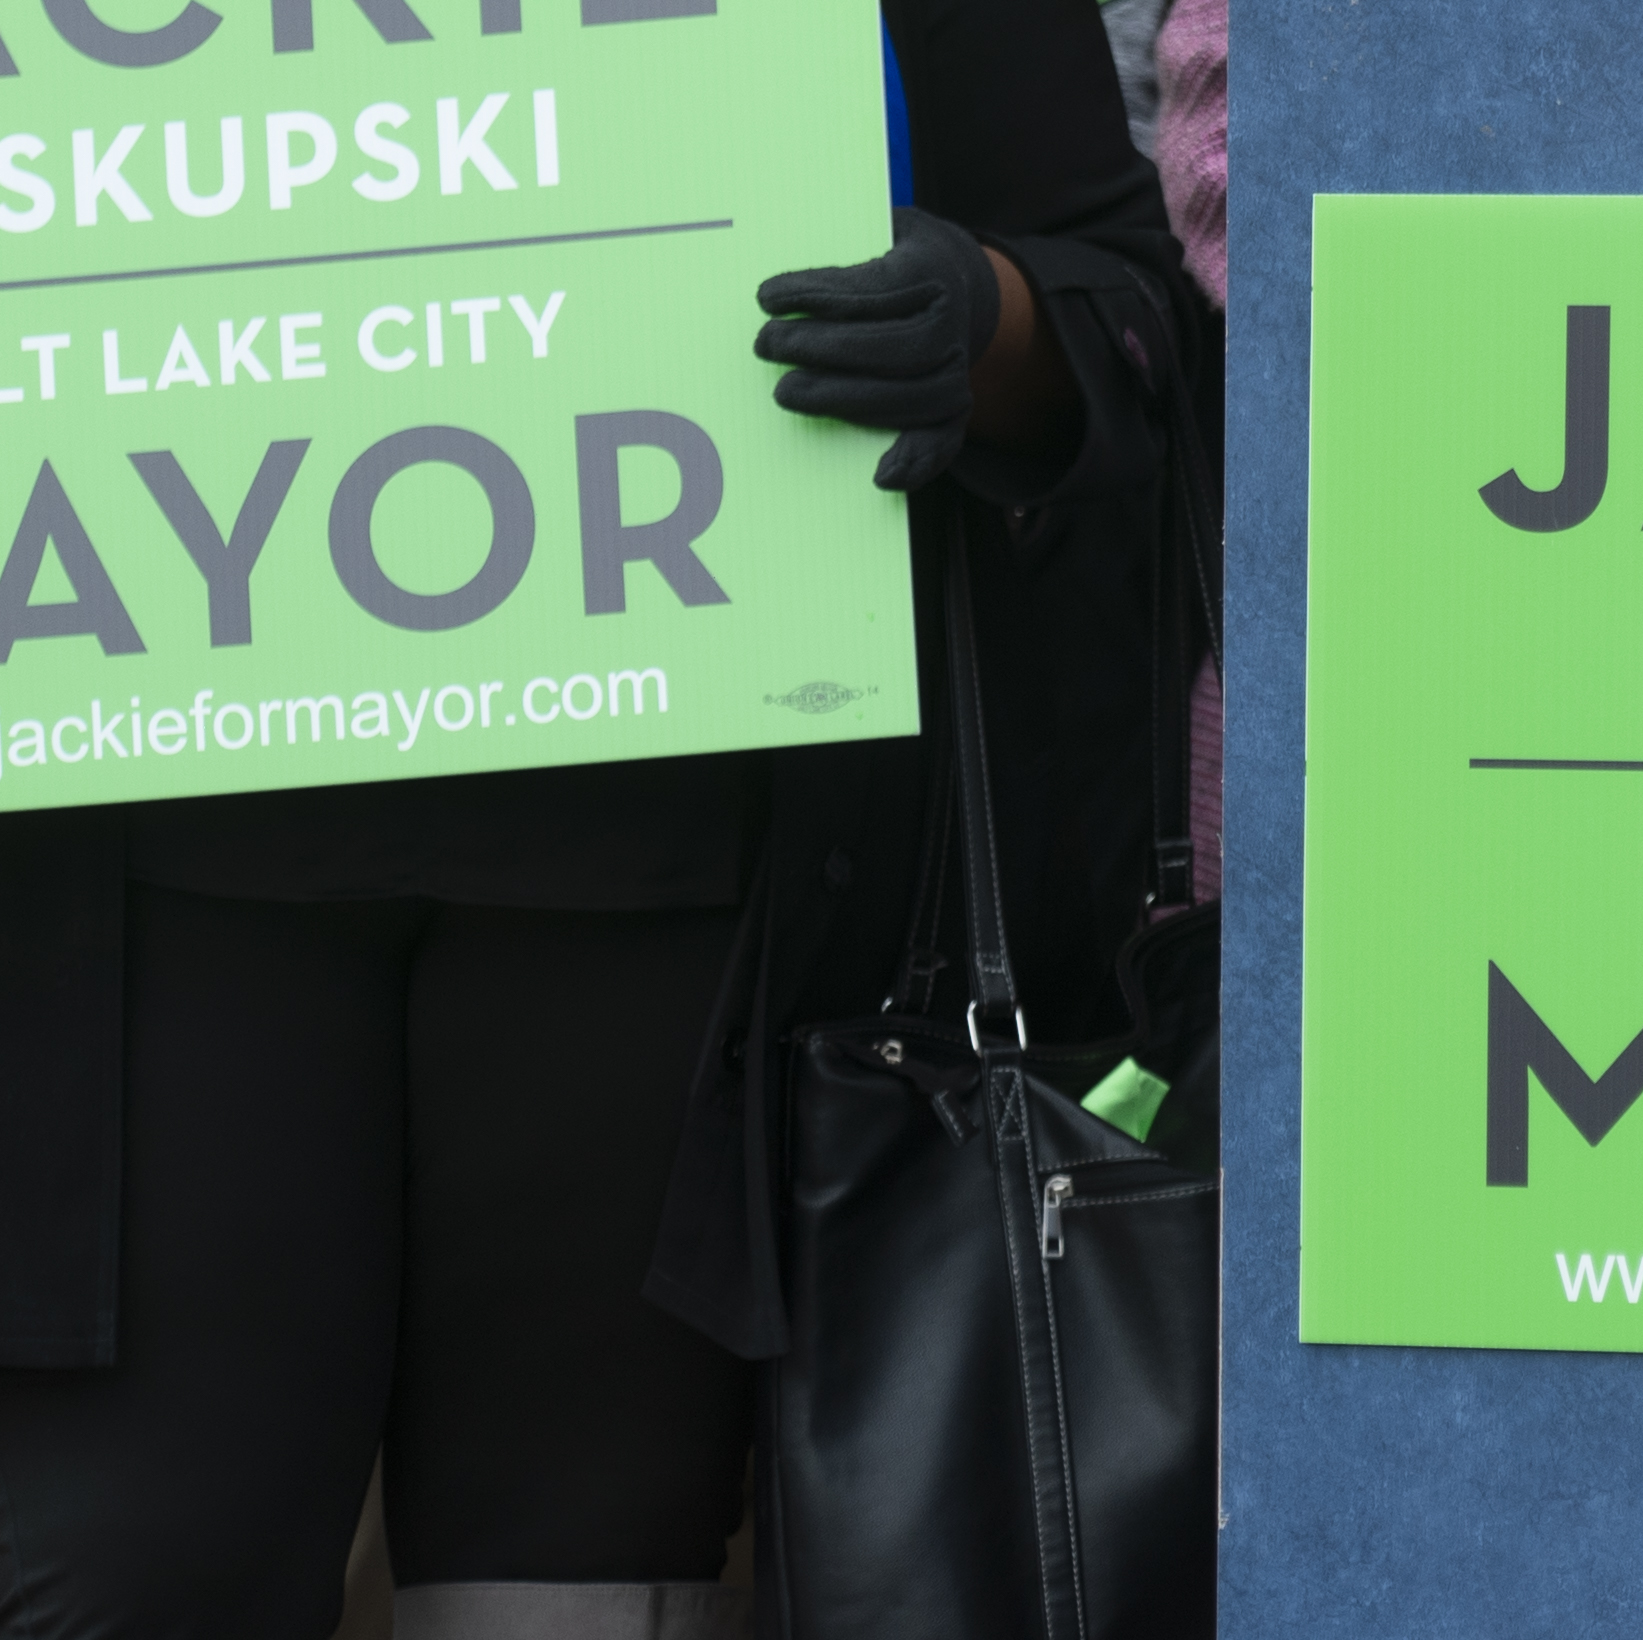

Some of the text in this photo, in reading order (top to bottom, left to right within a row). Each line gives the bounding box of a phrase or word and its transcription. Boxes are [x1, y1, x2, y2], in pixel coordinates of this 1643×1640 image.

[102, 312, 327, 395] LAKE
[357, 291, 566, 372] CITY
[0, 667, 669, 778] ackieformayor.com
